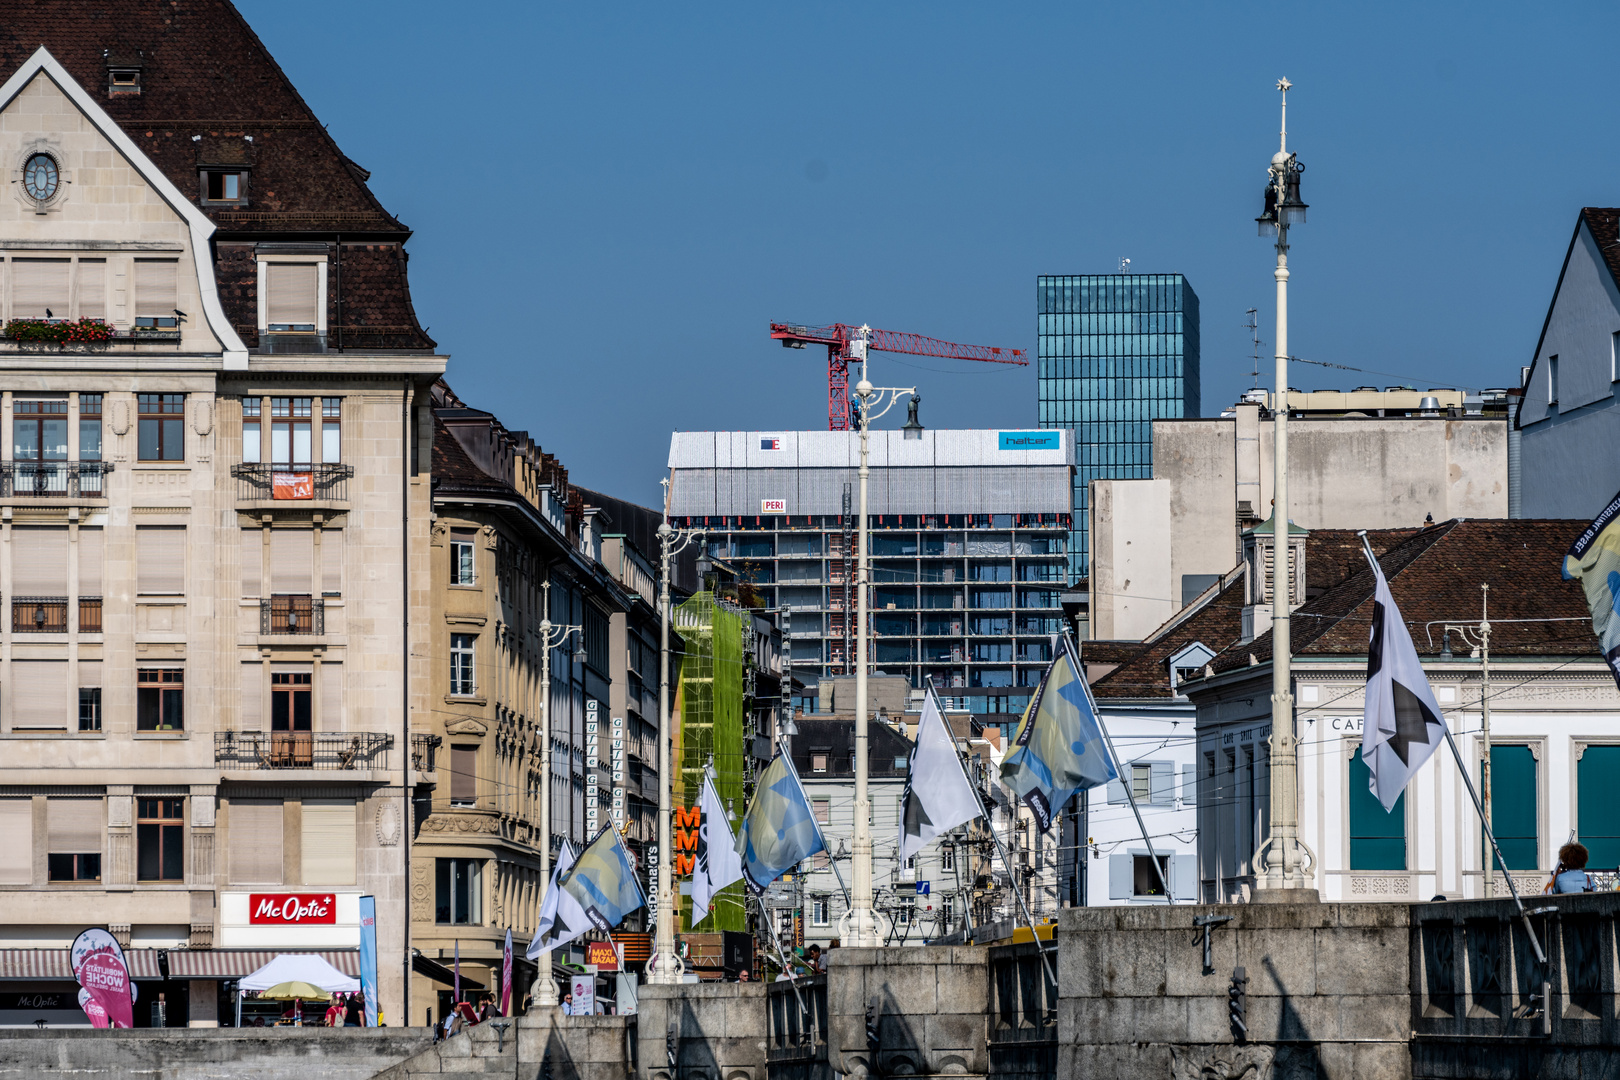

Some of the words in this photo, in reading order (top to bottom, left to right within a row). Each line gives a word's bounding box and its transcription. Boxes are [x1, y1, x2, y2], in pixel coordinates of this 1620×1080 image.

[1006, 437, 1052, 445] halter
[765, 501, 784, 509] PERI
[587, 701, 597, 766] Gryffe
[1240, 729, 1252, 741] SPITZ
[613, 718, 623, 780] Gryffe
[592, 949, 613, 957] MAXI
[592, 956, 617, 964] BAZAR
